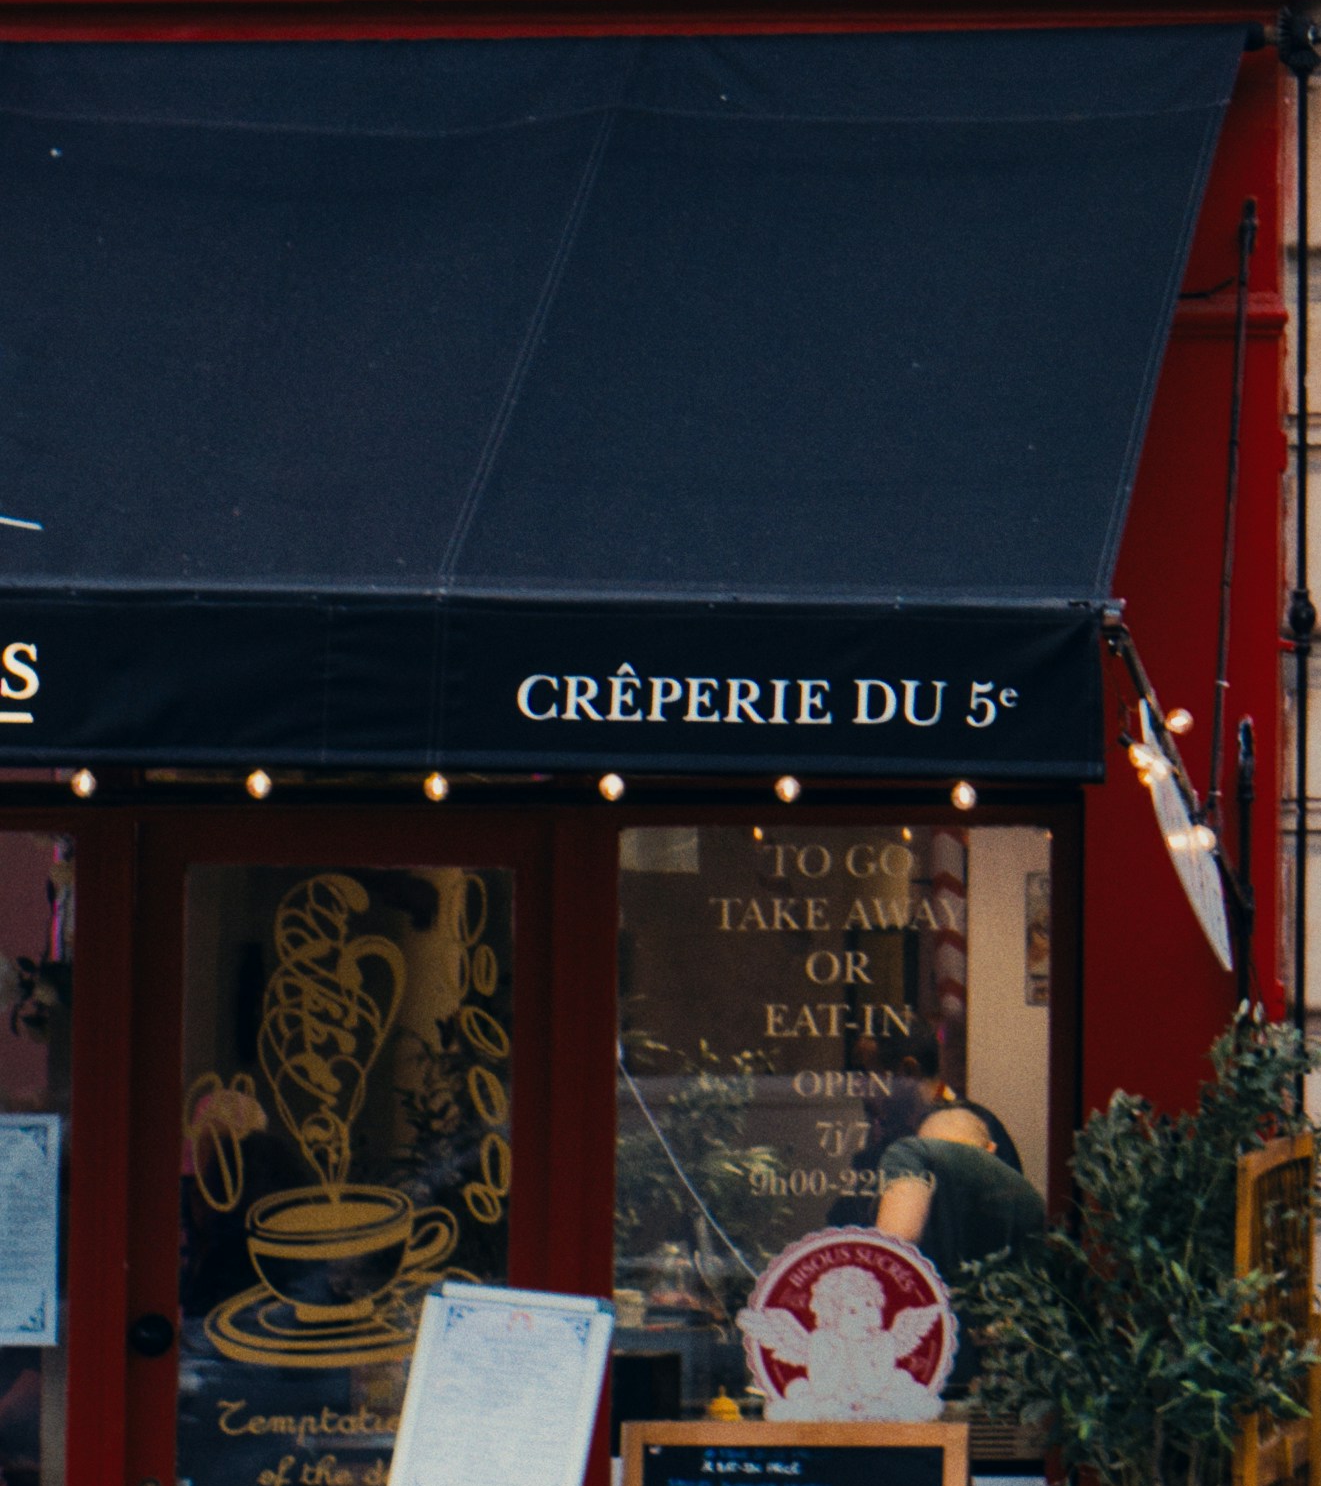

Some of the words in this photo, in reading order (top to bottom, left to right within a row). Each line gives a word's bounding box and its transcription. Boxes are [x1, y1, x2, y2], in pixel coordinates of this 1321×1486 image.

[516, 661, 832, 723] CRÊPERIE
[852, 678, 948, 726] DU
[763, 843, 832, 878] TO
[845, 843, 915, 878] GO
[708, 896, 832, 930] TAKE
[846, 896, 960, 930] AWAY
[805, 949, 874, 985] OR
[764, 1002, 915, 1038] EAT-IN
[792, 1069, 894, 1098] OPEN
[300, 1454, 354, 1486] the
